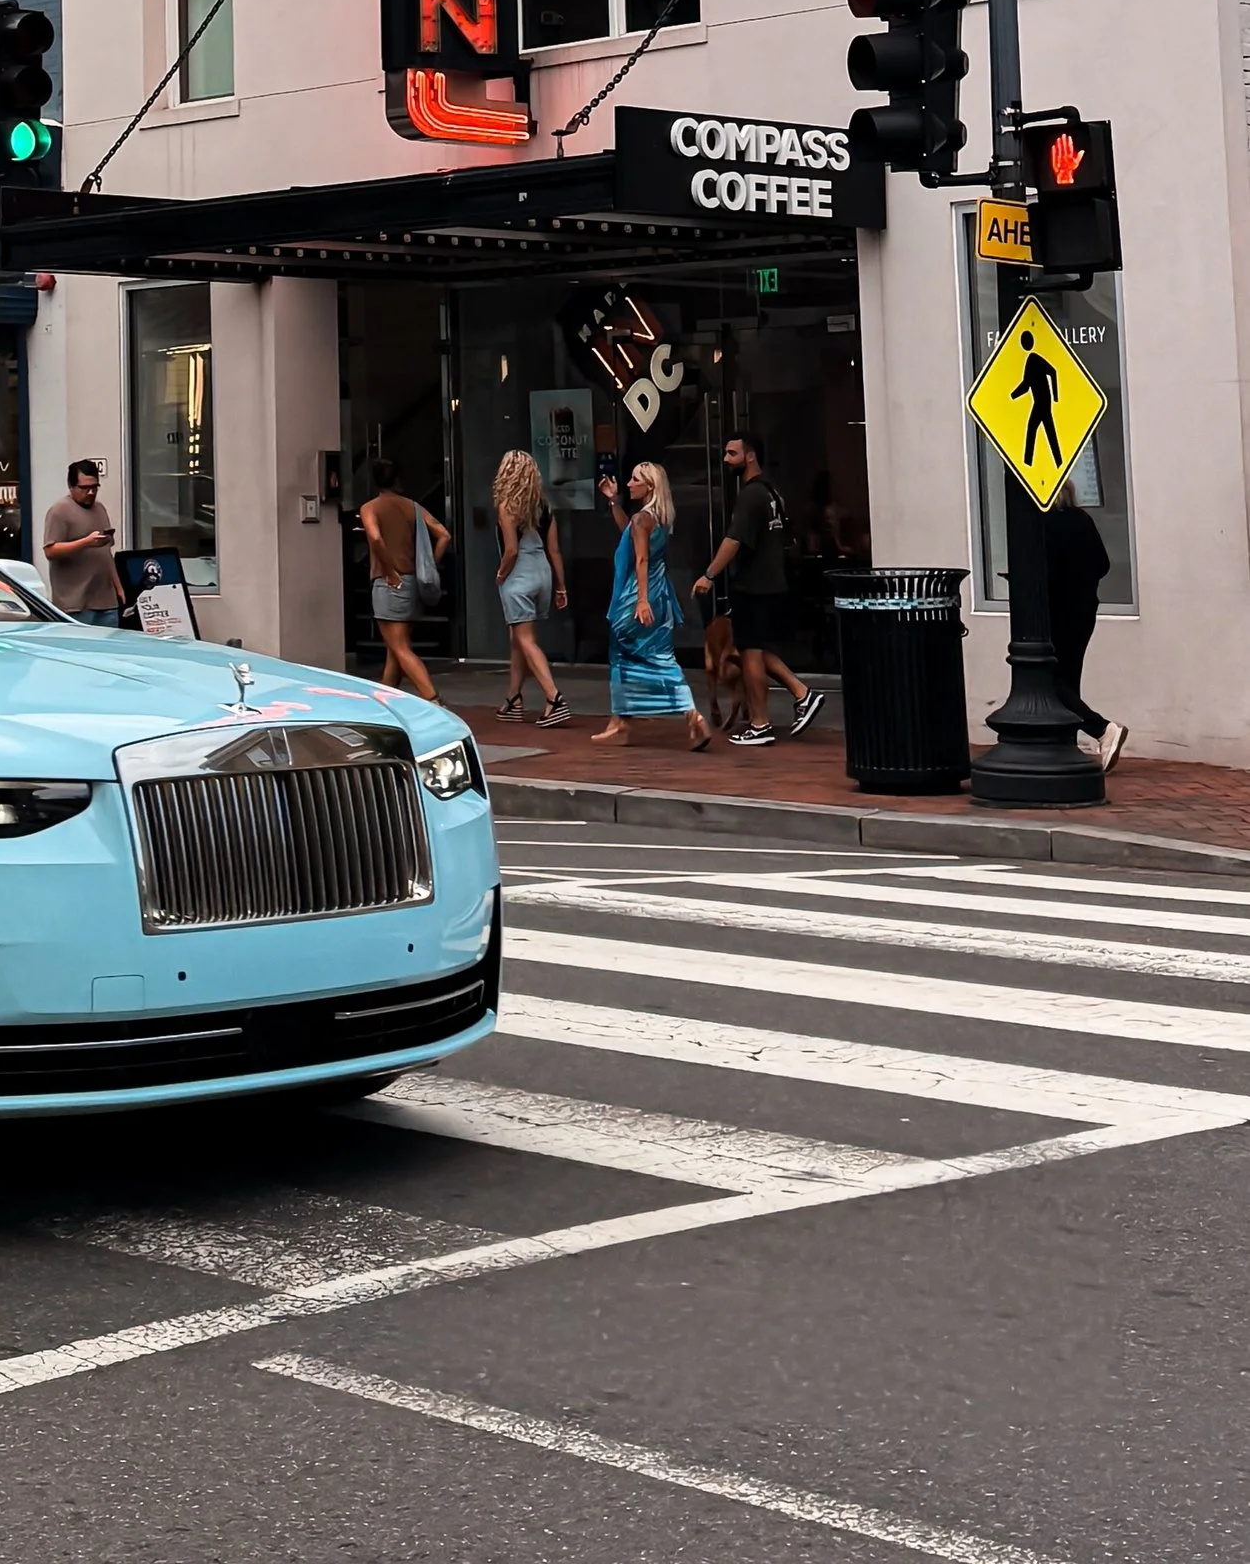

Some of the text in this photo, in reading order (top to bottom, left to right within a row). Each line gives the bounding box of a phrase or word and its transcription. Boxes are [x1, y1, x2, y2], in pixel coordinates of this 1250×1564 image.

[670, 117, 851, 171] COMPASS
[691, 169, 833, 218] COFFEE
[987, 217, 1031, 246] AHE
[623, 344, 684, 433] DC
